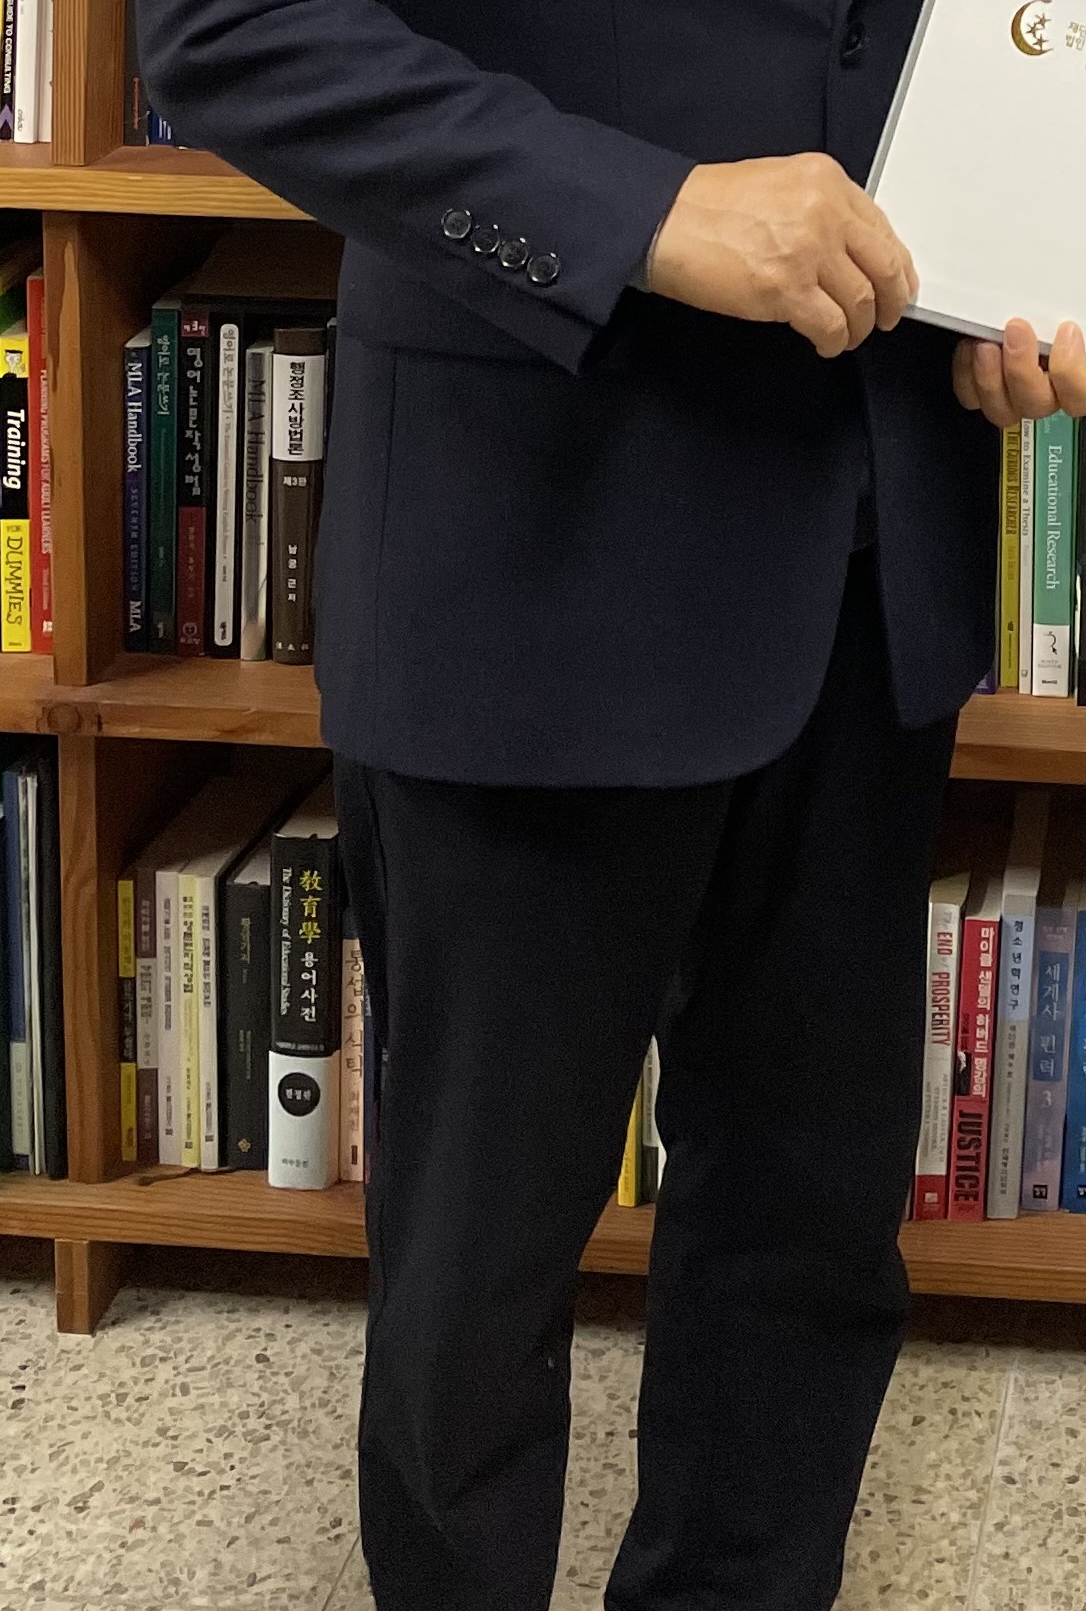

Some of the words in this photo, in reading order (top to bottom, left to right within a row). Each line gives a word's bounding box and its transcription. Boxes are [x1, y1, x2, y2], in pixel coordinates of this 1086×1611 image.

[126, 361, 143, 397] MLA
[247, 379, 266, 423] MLA
[288, 361, 306, 456] 행정조사방법론
[3, 409, 25, 489] Training
[127, 400, 142, 473] Handbook
[245, 430, 264, 524] Handbook
[1048, 445, 1063, 526] Educational
[6, 536, 25, 627] DUMMIES
[1046, 529, 1061, 591] Research
[937, 932, 953, 956] END
[300, 951, 317, 1023] 용어사전
[931, 972, 951, 1047] PROSPERITY
[1042, 963, 1061, 1022] 세계사
[1039, 1033, 1057, 1077] 편력
[953, 1109, 984, 1203] JUSTICE
